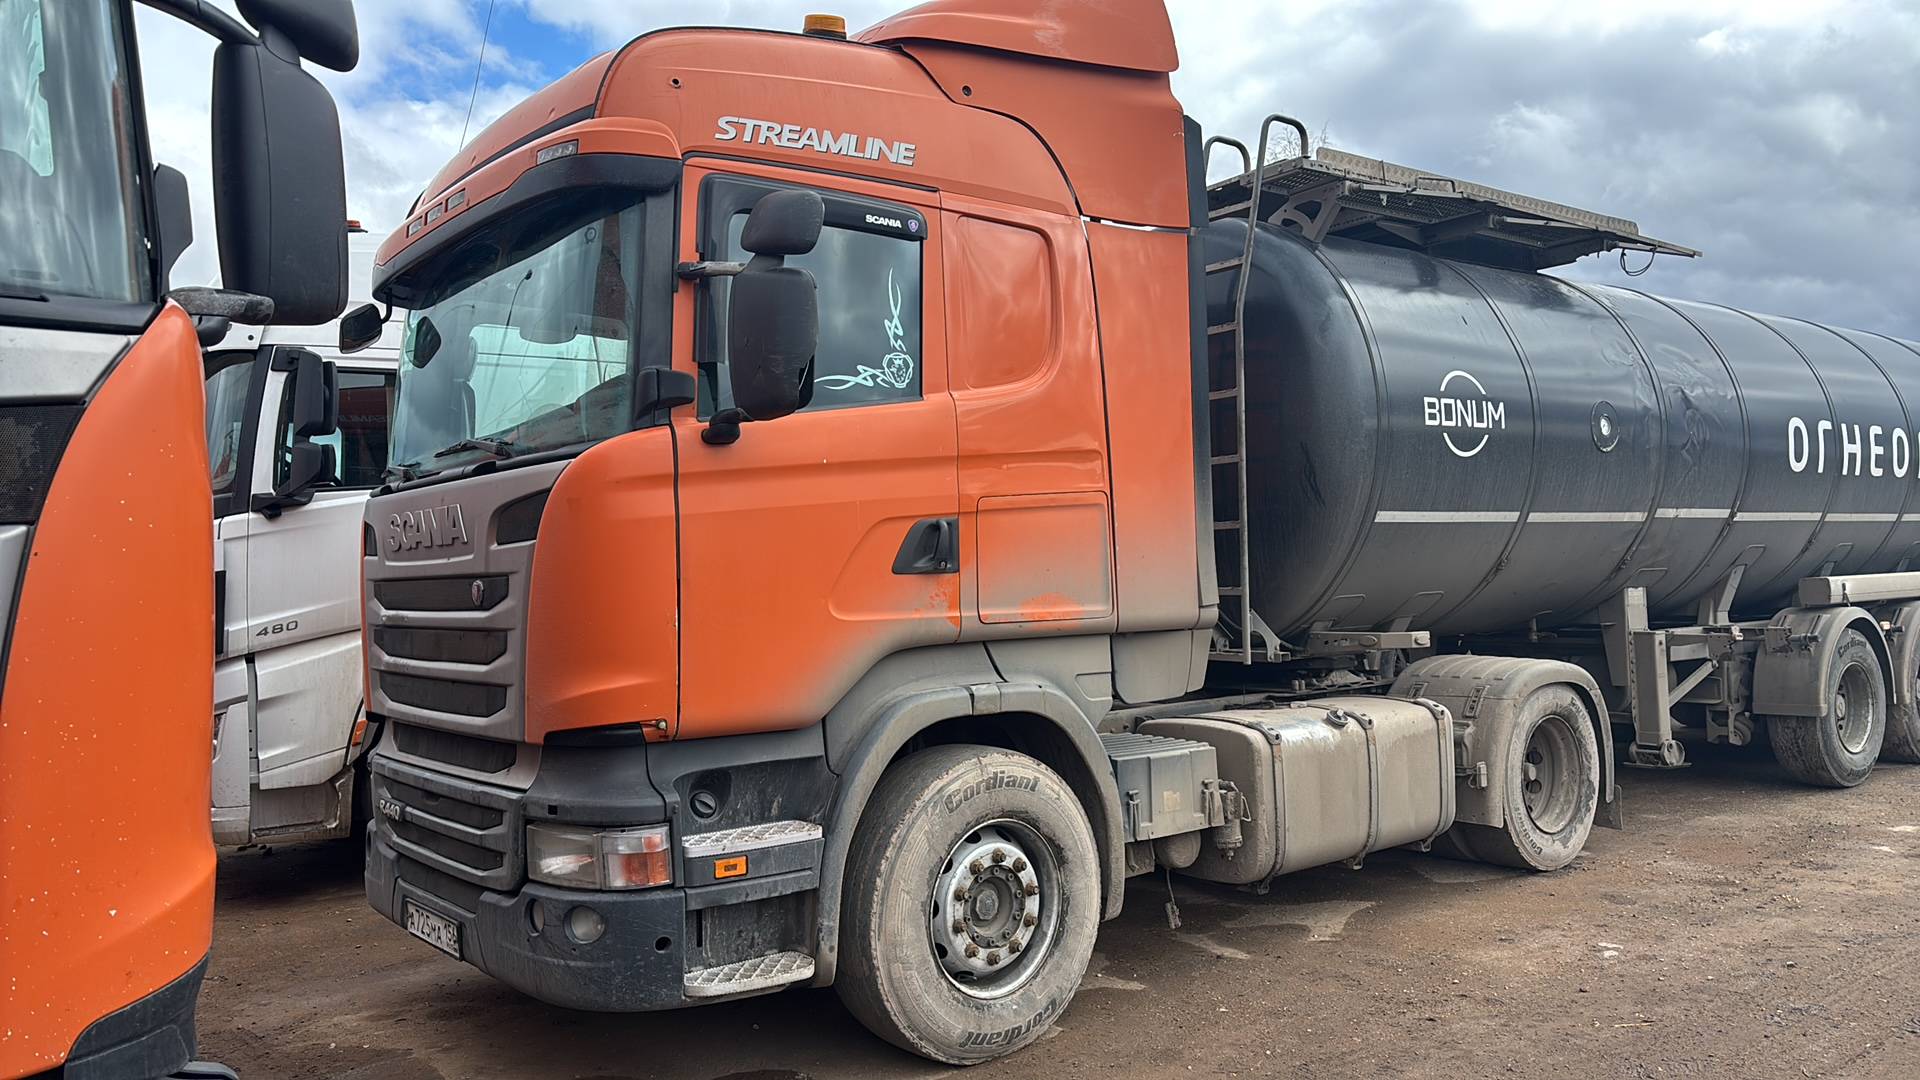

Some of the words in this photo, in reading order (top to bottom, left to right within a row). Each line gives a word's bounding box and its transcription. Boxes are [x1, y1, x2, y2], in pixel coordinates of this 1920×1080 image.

[714, 115, 916, 166] STREAMLINE
[865, 213, 902, 229] SCANIA
[1423, 396, 1505, 429] BONUM
[1787, 416, 1920, 479] ОГНЕО
[388, 503, 468, 552] SCANIA
[256, 620, 298, 637] 480
[943, 769, 1041, 814] Cordiant
[958, 997, 1058, 1049] Cordiant
